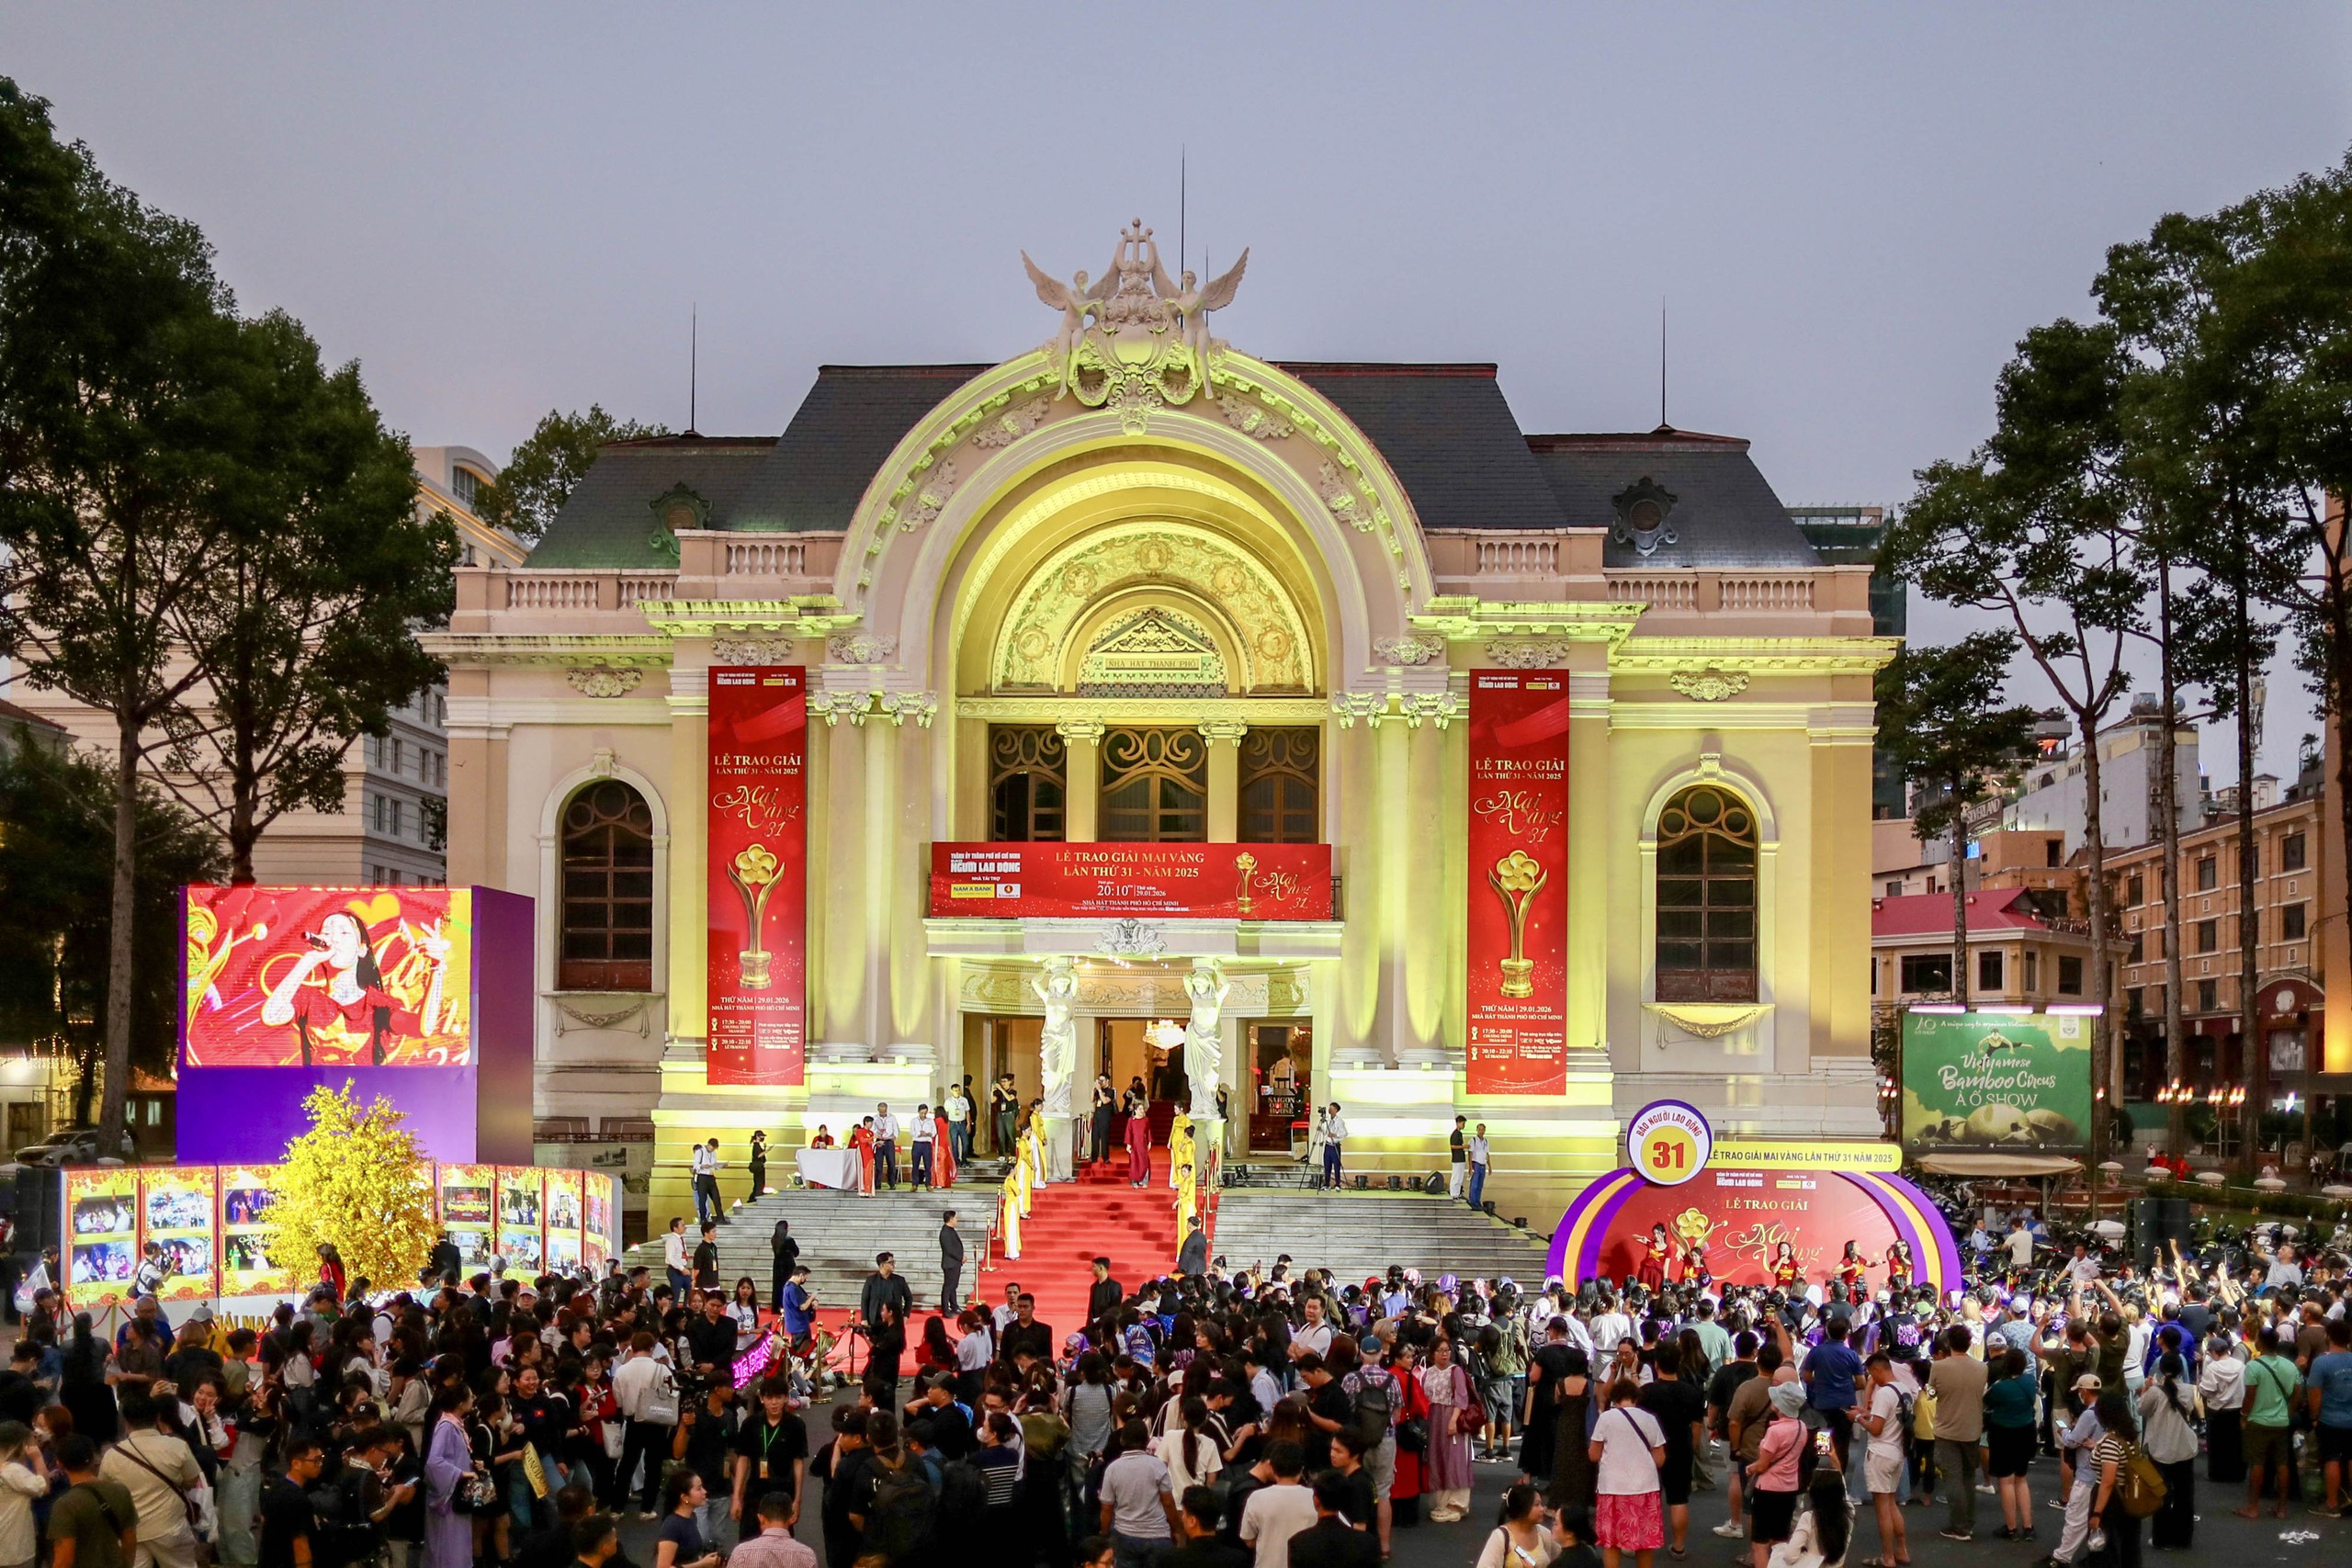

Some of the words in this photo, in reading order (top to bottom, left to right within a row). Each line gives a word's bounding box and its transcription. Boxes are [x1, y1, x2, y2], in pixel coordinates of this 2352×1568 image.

[715, 753, 730, 765] LỄ
[733, 756, 770, 766] TRAO
[773, 753, 801, 766] GIẢI
[1476, 757, 1492, 770] LỄ
[1495, 760, 1532, 771] TRAO
[1535, 757, 1565, 771] GIẢI
[1495, 771, 1512, 779] THỨ
[725, 785, 779, 805] Mai
[1487, 791, 1541, 809] Mai
[764, 821, 786, 837] 31
[1526, 828, 1549, 843] 31
[1056, 850, 1071, 862] LỄ
[1074, 852, 1109, 863] TRAO
[1111, 850, 1138, 863] GIẢI
[1142, 852, 1166, 863] MAI
[1169, 851, 1204, 863] VÀNG
[978, 862, 995, 873] LAO
[997, 861, 1021, 873] ĐỘNG
[1064, 864, 1089, 876] LẦN
[1091, 864, 1119, 876] THỨ
[1121, 867, 1132, 876] 31
[1143, 865, 1171, 876] NĂM
[1174, 867, 1199, 877] 2025
[1262, 873, 1297, 885] Mai
[1097, 885, 1128, 897] 20:10
[1293, 897, 1307, 908] 31
[1481, 1004, 1497, 1012] THỨ
[1961, 1051, 2030, 1072] Vietnamese
[1938, 1066, 2015, 1090] Bamboo
[2017, 1071, 2056, 1089] Circus
[1955, 1090, 1967, 1106] À
[1986, 1093, 2038, 1106] SHOW
[1636, 1122, 1649, 1136] BÁO
[1648, 1110, 1670, 1125] NGƯỜI
[1672, 1112, 1686, 1124] LAO
[1685, 1119, 1702, 1136] ĐỘNG
[1653, 1142, 1684, 1168] 31
[1721, 1151, 1743, 1160] TRAO
[1746, 1150, 1762, 1160] GIẢI
[1764, 1152, 1779, 1160] MAI
[1781, 1150, 1803, 1161] VÀNG
[1805, 1151, 1821, 1161] LẦN
[1825, 1151, 1841, 1162] THỨ
[1843, 1154, 1851, 1162] 31
[1854, 1151, 1871, 1162] NĂM
[1874, 1154, 1893, 1163] 2025
[1725, 1198, 1741, 1209] LỄ
[1744, 1200, 1778, 1210] TRAO
[1781, 1199, 1808, 1211] GIẢI
[1740, 1224, 1800, 1244] Mai
